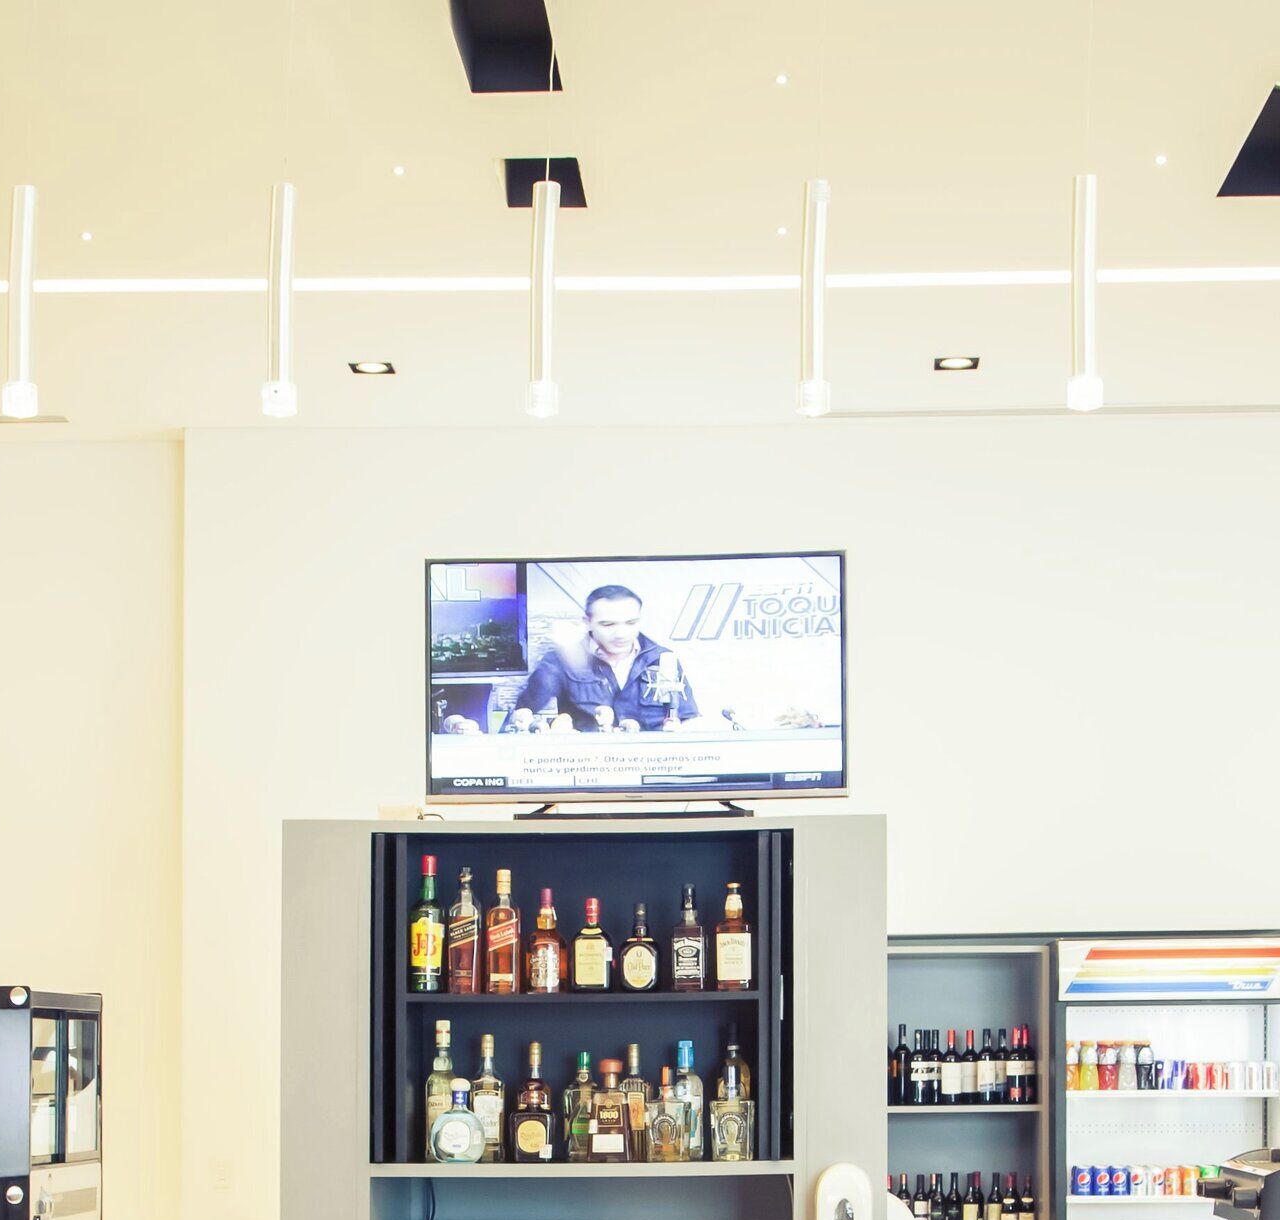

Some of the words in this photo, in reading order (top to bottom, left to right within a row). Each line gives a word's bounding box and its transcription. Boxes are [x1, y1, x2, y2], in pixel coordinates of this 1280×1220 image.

[453, 778, 484, 787] COPA
[485, 777, 505, 786] ING
[599, 1110, 620, 1120] 1800
